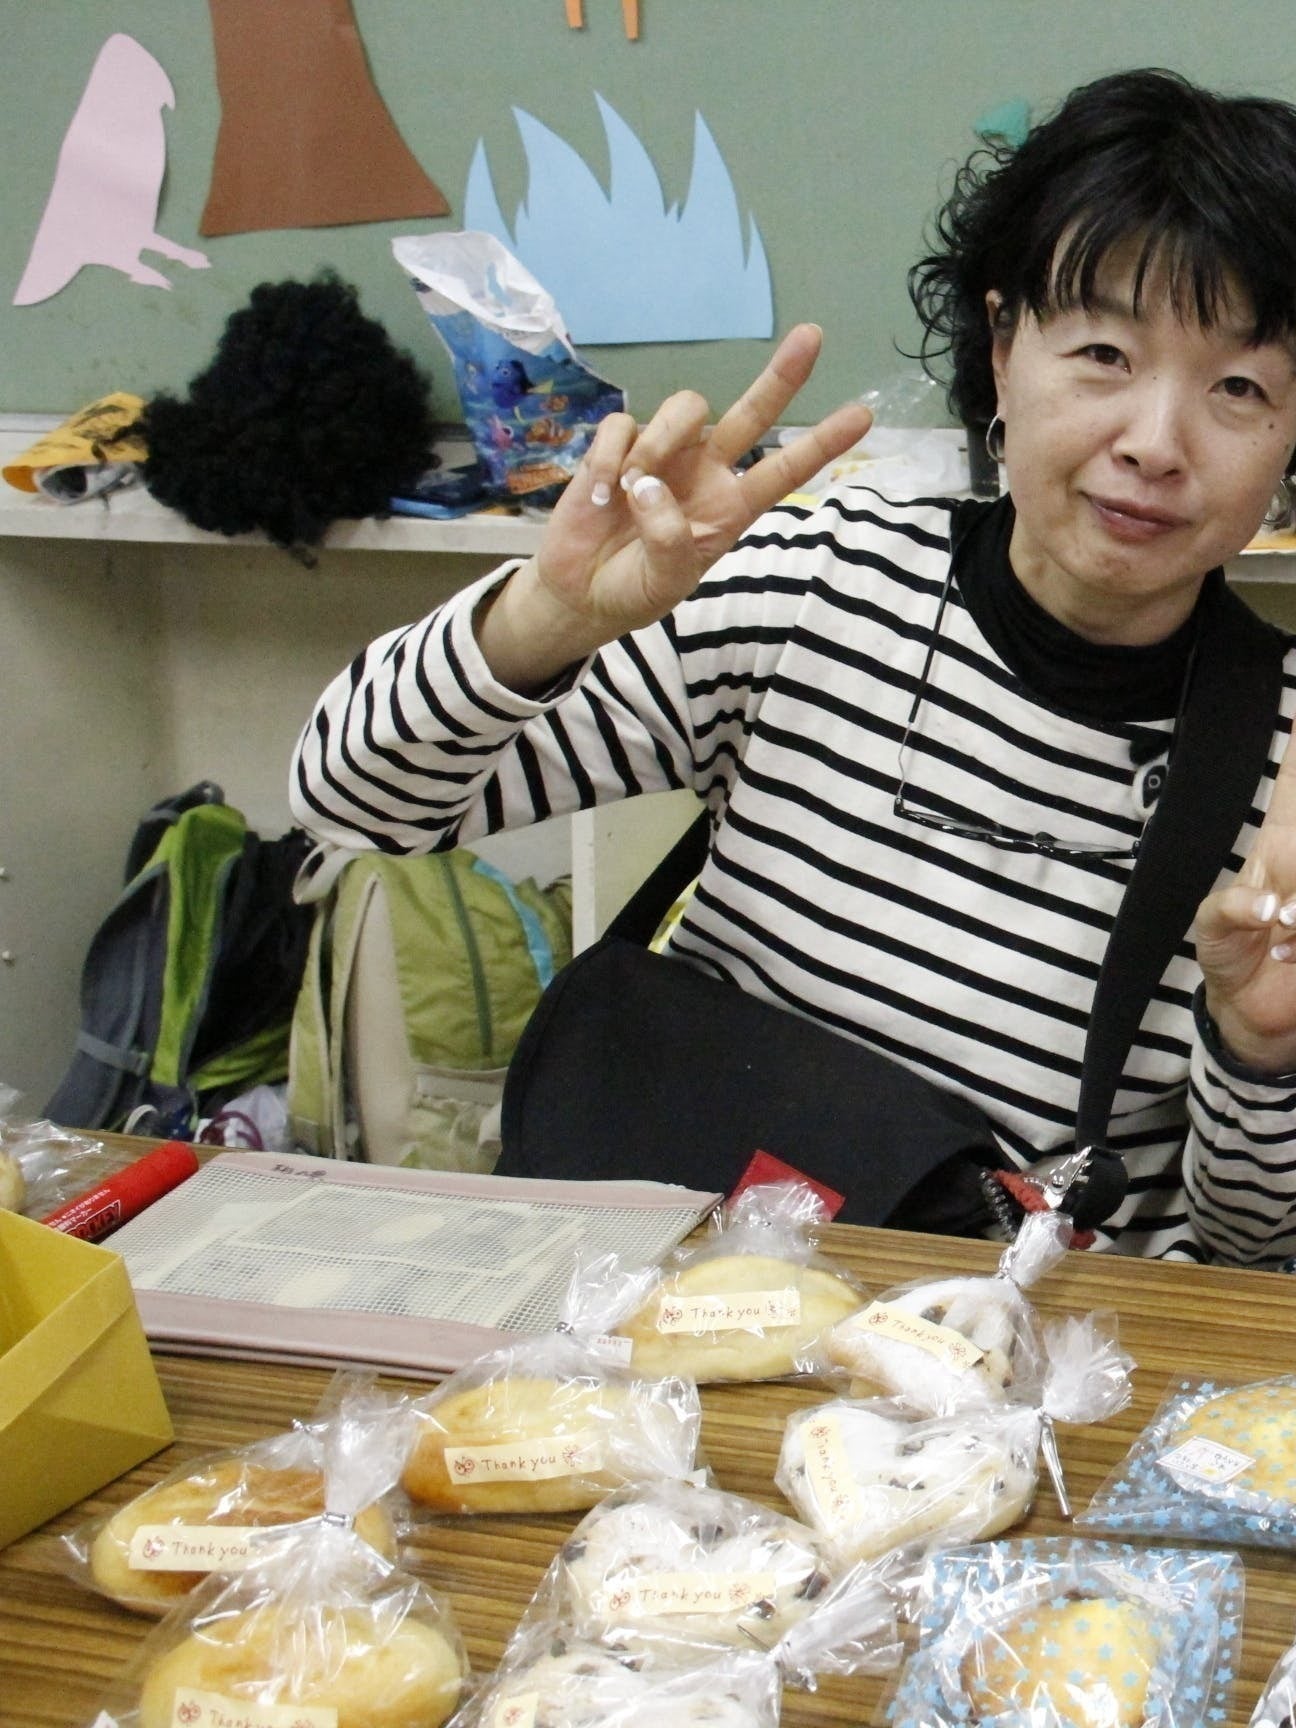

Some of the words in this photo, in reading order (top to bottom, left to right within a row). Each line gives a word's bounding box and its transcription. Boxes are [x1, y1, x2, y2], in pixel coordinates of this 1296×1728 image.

[690, 1306, 733, 1319] Thank
[738, 1308, 760, 1320] you
[481, 1456, 526, 1471] Thank
[530, 1455, 556, 1472] you
[172, 1541, 214, 1556] Thank
[219, 1545, 248, 1561] you
[639, 1587, 689, 1601] Thank
[694, 1592, 722, 1604] you
